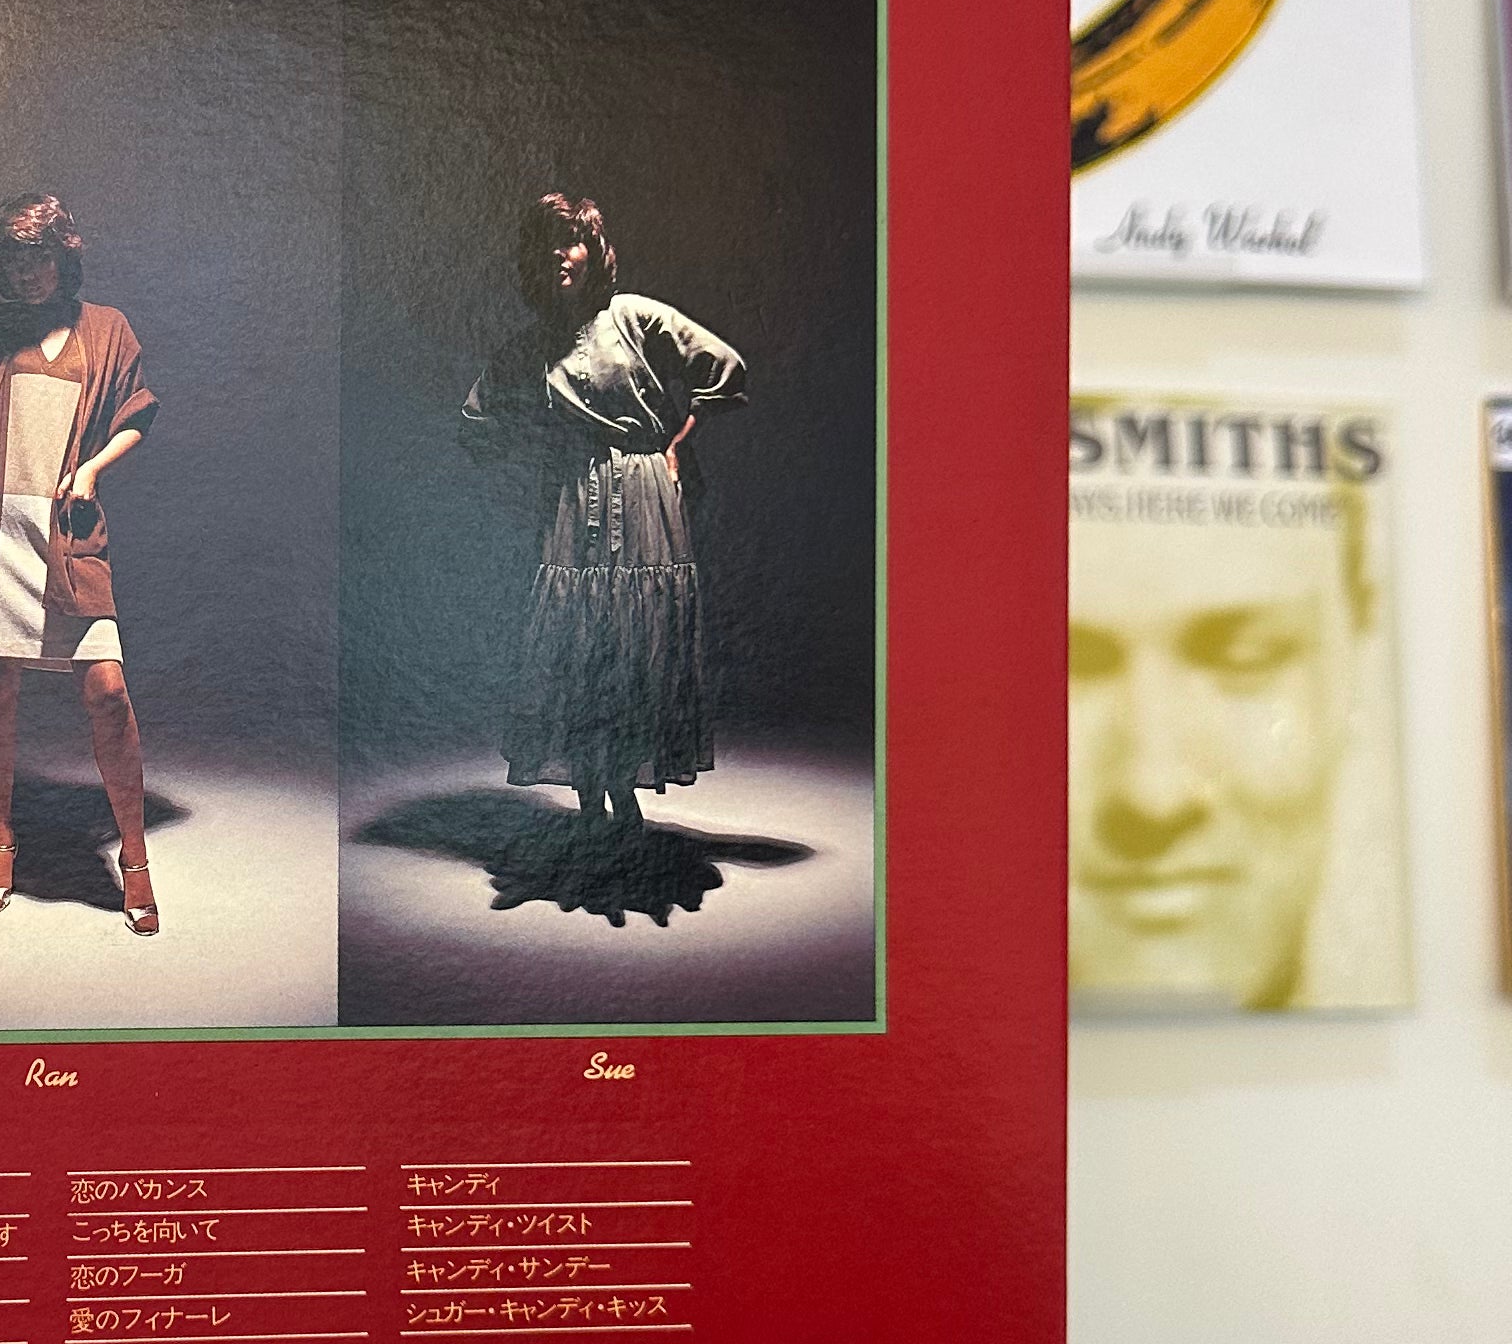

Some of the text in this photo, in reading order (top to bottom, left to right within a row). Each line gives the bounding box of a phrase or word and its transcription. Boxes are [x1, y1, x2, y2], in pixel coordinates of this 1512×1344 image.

[1068, 408, 1382, 484] SMITHS
[24, 1057, 79, 1088] Ran
[583, 1051, 636, 1080] Sue
[69, 1177, 209, 1204] 恋のバカンス
[406, 1171, 501, 1197] キャンディ
[71, 1217, 221, 1244] こっちを向いて
[406, 1212, 593, 1238] キャンディ・ツイスト
[69, 1261, 188, 1290] 恋のフーガ
[406, 1255, 611, 1283] キャンディ・サンデー
[68, 1305, 232, 1334] 愛のフィナーレ
[406, 1294, 668, 1325] シュガー・キャンディ・キッス
